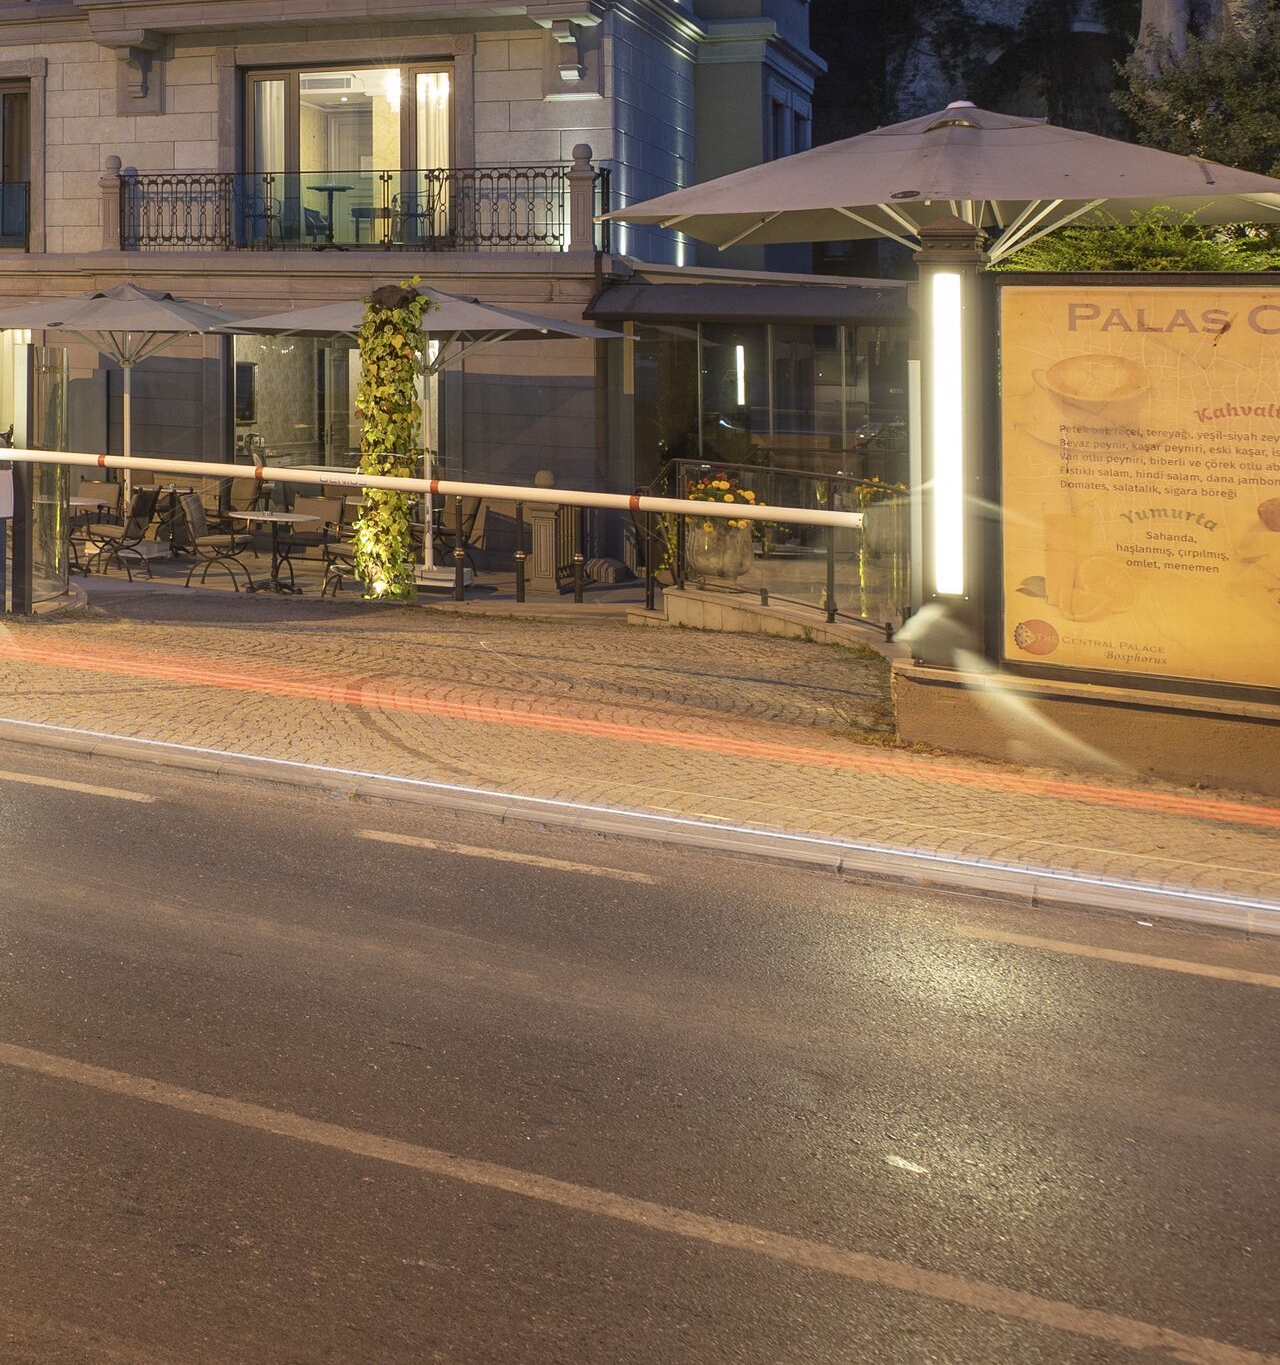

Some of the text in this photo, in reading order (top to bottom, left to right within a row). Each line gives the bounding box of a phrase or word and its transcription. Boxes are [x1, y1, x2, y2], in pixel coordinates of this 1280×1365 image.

[1067, 303, 1232, 334] PALAS
[1146, 429, 1194, 440] tereyağı,
[1197, 430, 1258, 442] yeşil-siyah
[1132, 442, 1161, 452] kaşar
[1164, 444, 1206, 455] peyniri,
[1209, 446, 1231, 454] eski
[1235, 447, 1268, 457] kaşar,
[1082, 453, 1103, 462] otlu
[1150, 456, 1186, 467] biberli
[1189, 460, 1201, 468] ve
[1205, 459, 1236, 470] çörek
[1239, 462, 1262, 471] otlu
[1097, 468, 1133, 479] salam,
[1136, 470, 1164, 480] hindi
[1167, 472, 1203, 483] salam,
[1206, 474, 1235, 484] dana
[1060, 480, 1237, 500] Domates, salatalık, sigara böreği
[1120, 507, 1218, 531] Yumurta
[1146, 531, 1198, 544] Sahanda,
[1116, 543, 1230, 561] haşlanmış, çırpılmış,
[1126, 558, 1220, 573] omlet, menemen
[1061, 636, 1117, 649] CENTRAL
[1119, 642, 1166, 653] PALACE
[1104, 650, 1168, 665] Bosphorus
